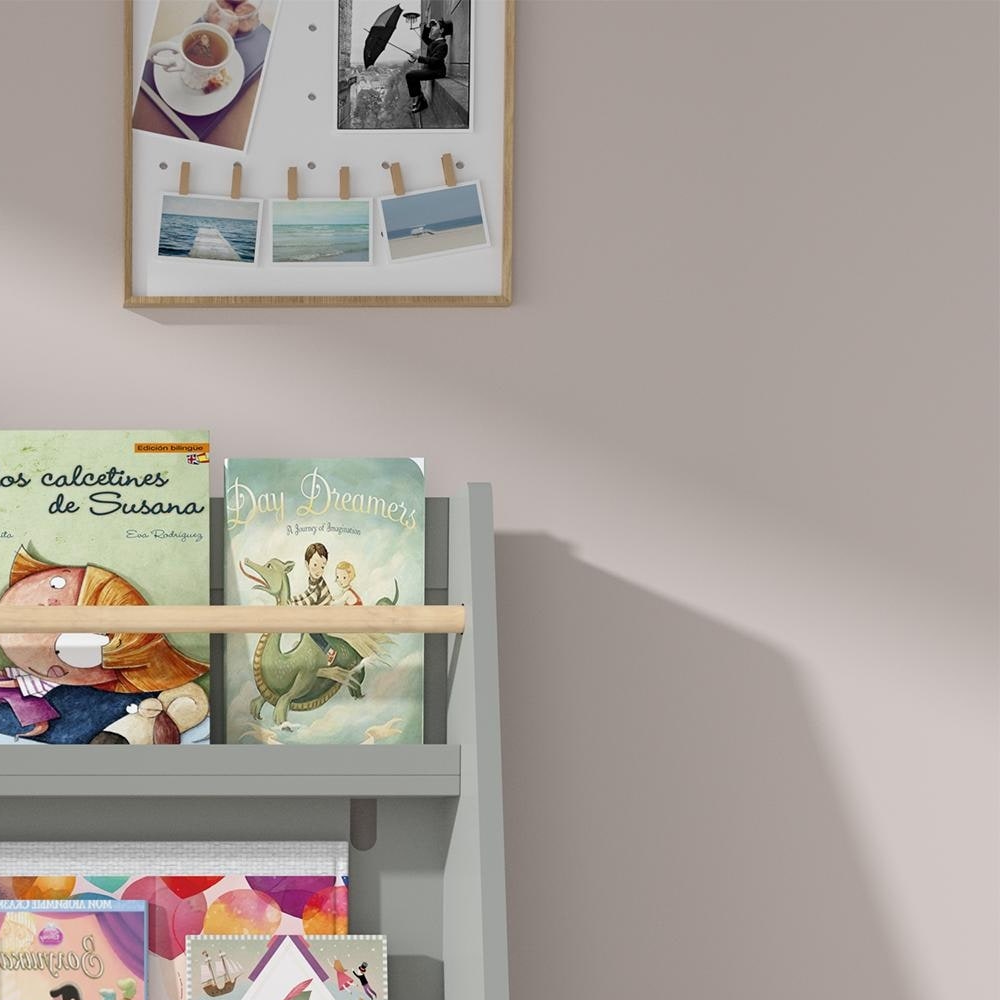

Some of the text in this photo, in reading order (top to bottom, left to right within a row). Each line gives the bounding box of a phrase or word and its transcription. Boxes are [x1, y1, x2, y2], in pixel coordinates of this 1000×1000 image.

[41, 465, 169, 487] calcetines
[48, 491, 205, 516] de Susana
[226, 466, 417, 530] Day Dreamers
[126, 529, 149, 540] Eva
